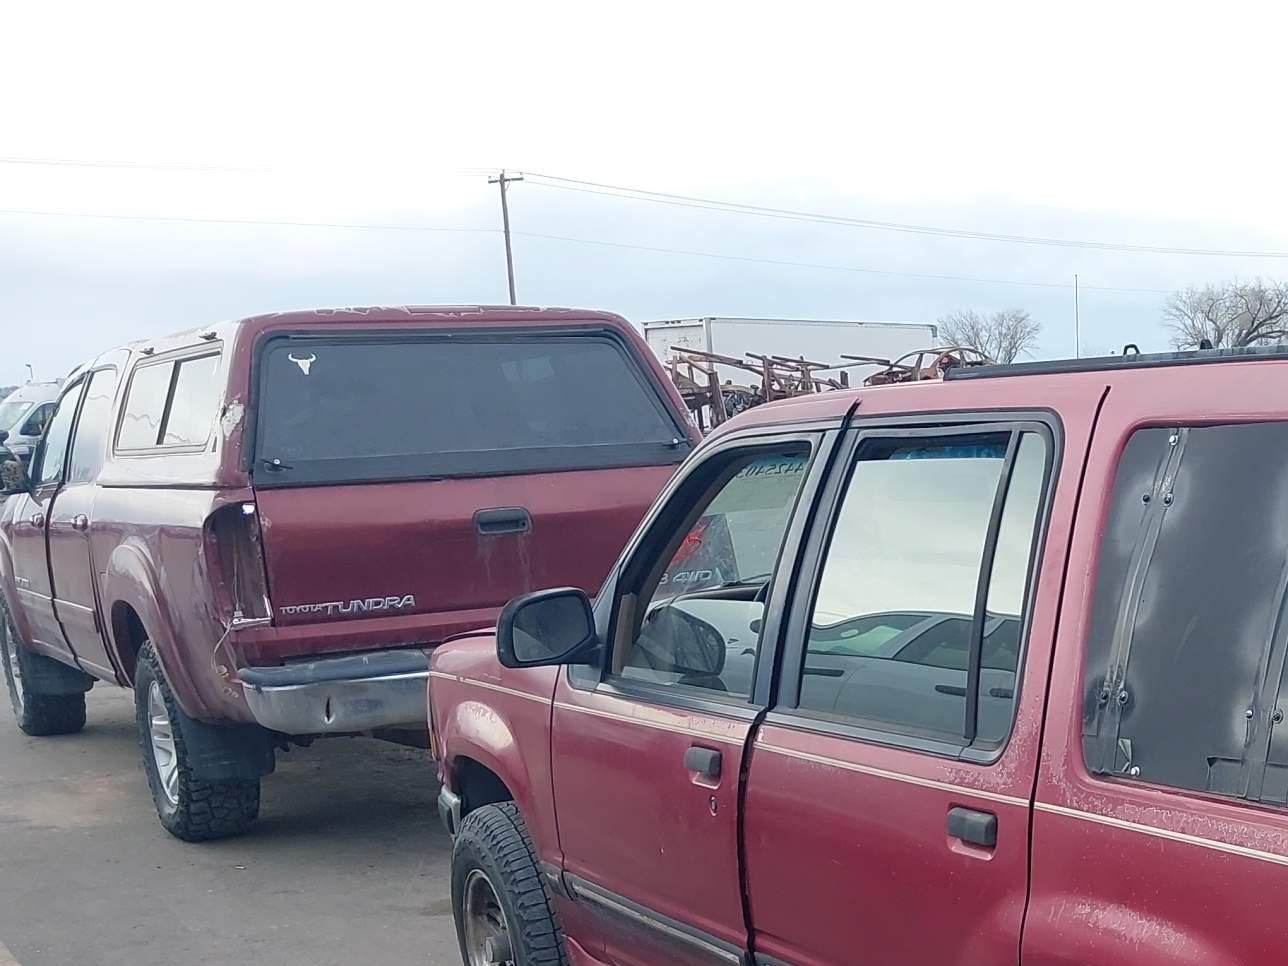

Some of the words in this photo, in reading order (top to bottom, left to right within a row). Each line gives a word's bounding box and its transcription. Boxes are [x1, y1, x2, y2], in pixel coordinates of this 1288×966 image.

[672, 569, 713, 583] 4WD
[279, 603, 323, 615] TOYOTA
[322, 594, 417, 616] TUNDRA
